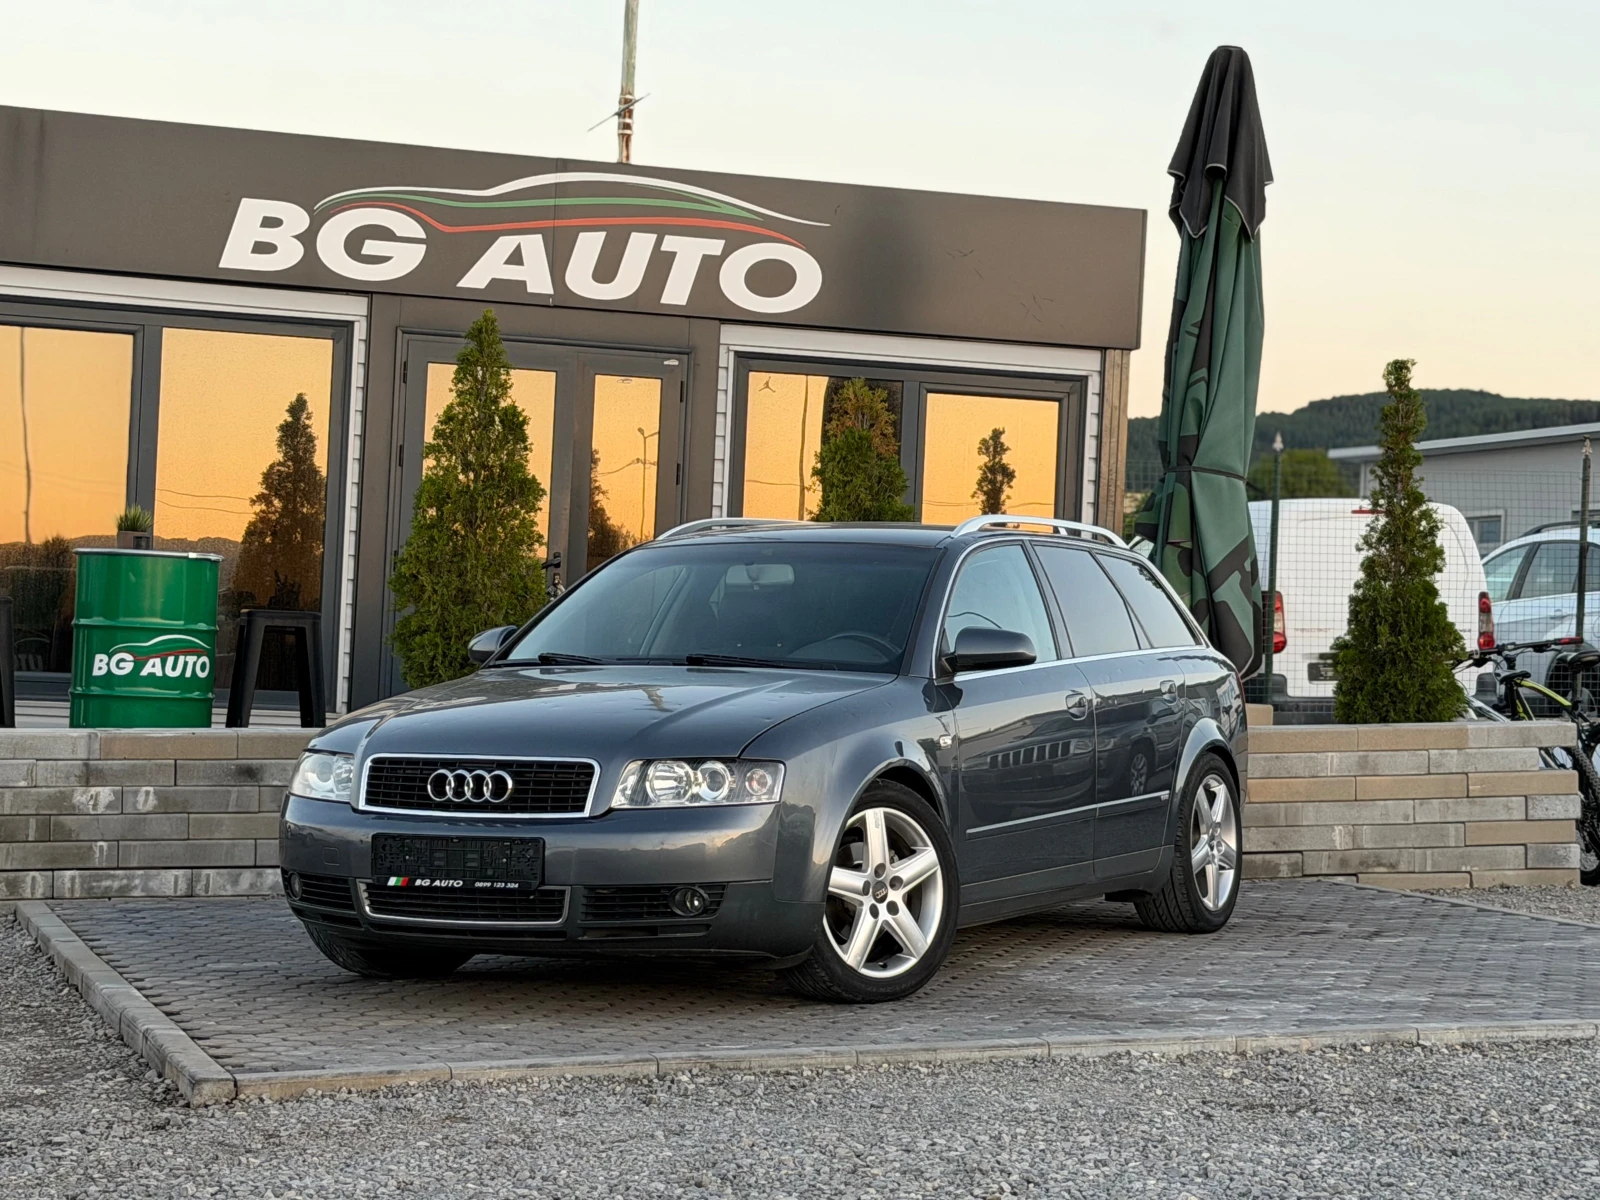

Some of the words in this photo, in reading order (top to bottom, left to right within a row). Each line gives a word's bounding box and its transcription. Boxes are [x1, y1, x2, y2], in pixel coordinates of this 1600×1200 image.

[218, 197, 427, 282] BG
[456, 230, 823, 314] AUTO
[92, 652, 135, 676] BG
[140, 655, 210, 678] AUTO
[414, 878, 431, 887] BG
[432, 879, 464, 888] AUTO
